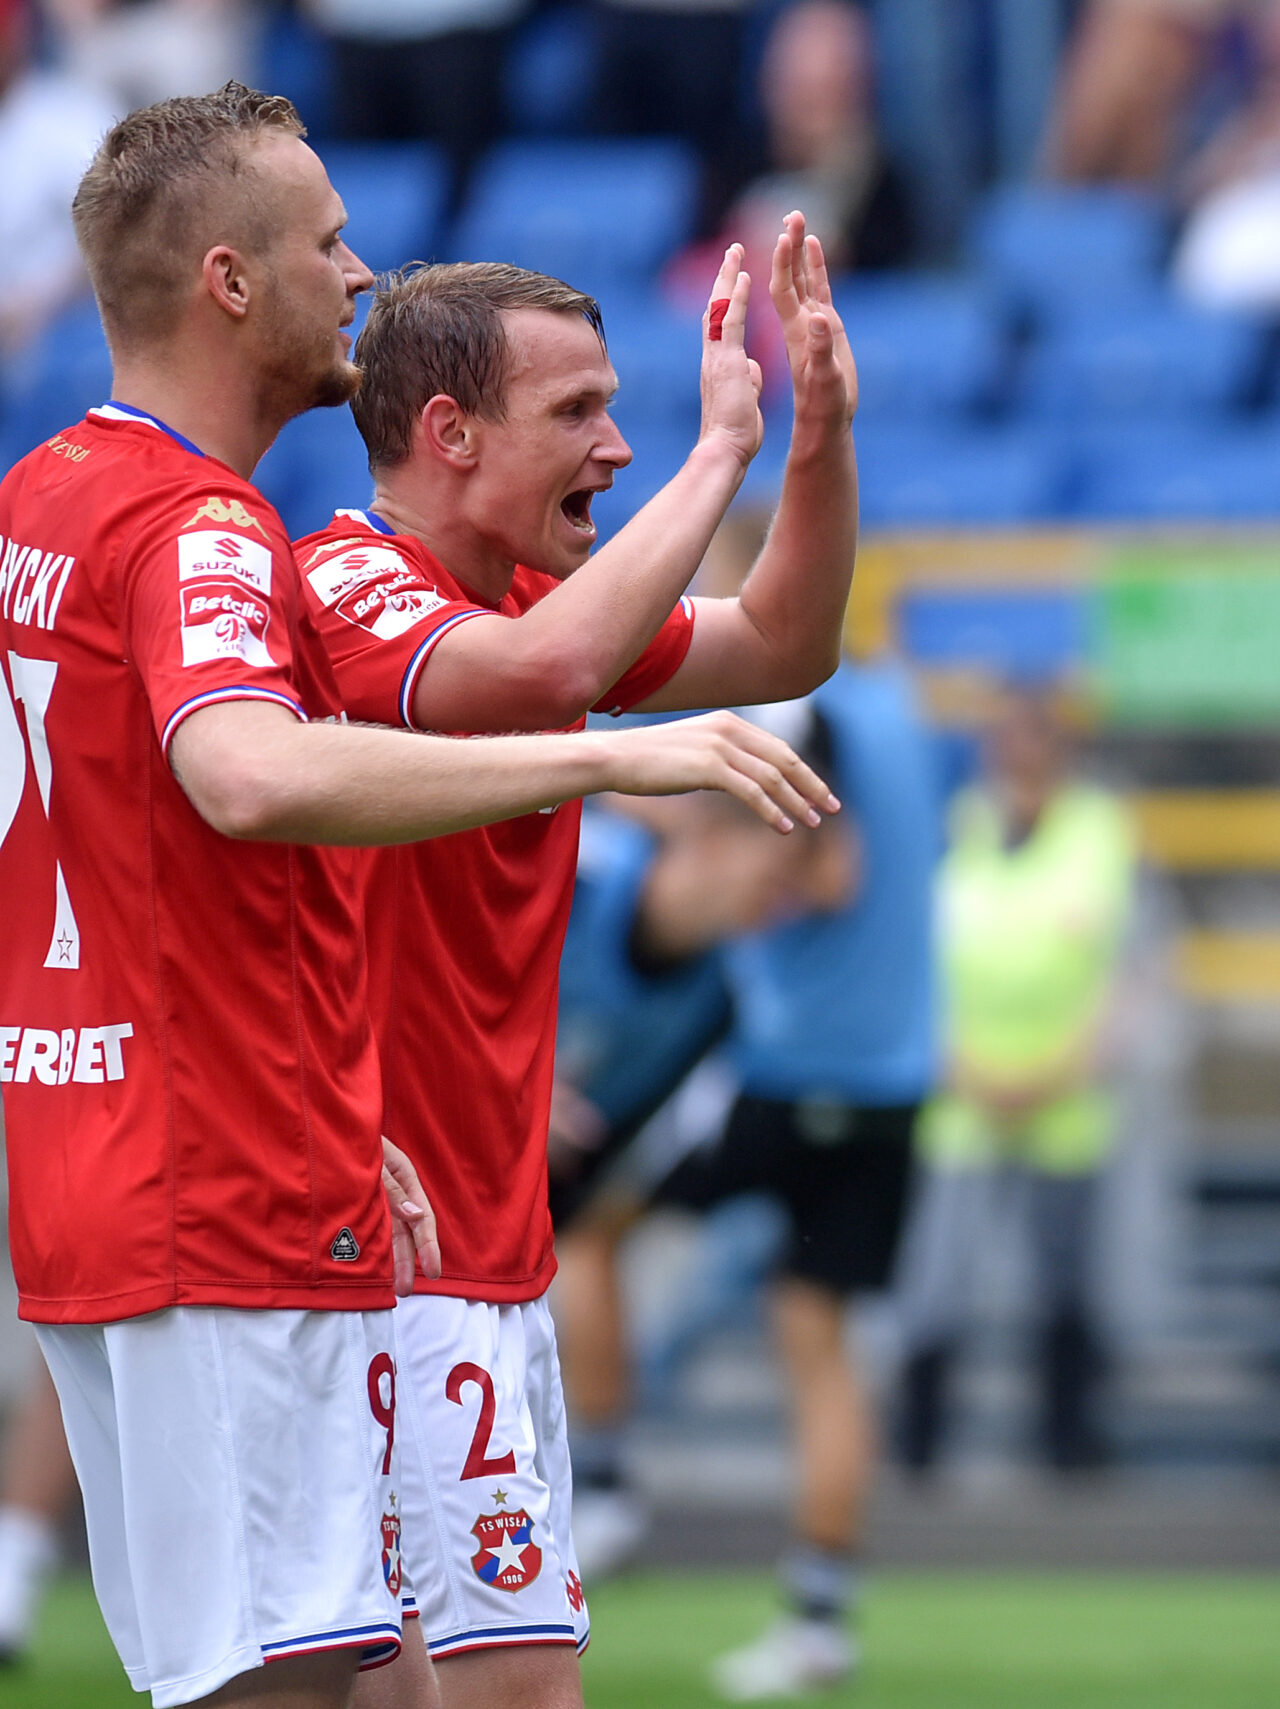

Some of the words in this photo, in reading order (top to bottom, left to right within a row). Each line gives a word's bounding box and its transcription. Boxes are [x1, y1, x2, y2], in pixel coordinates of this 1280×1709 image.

[192, 561, 260, 585] SUZUKI
[189, 594, 264, 624] Betclic
[446, 1361, 516, 1481] 2
[480, 1520, 495, 1533] TS
[502, 1574, 523, 1585] 1906
